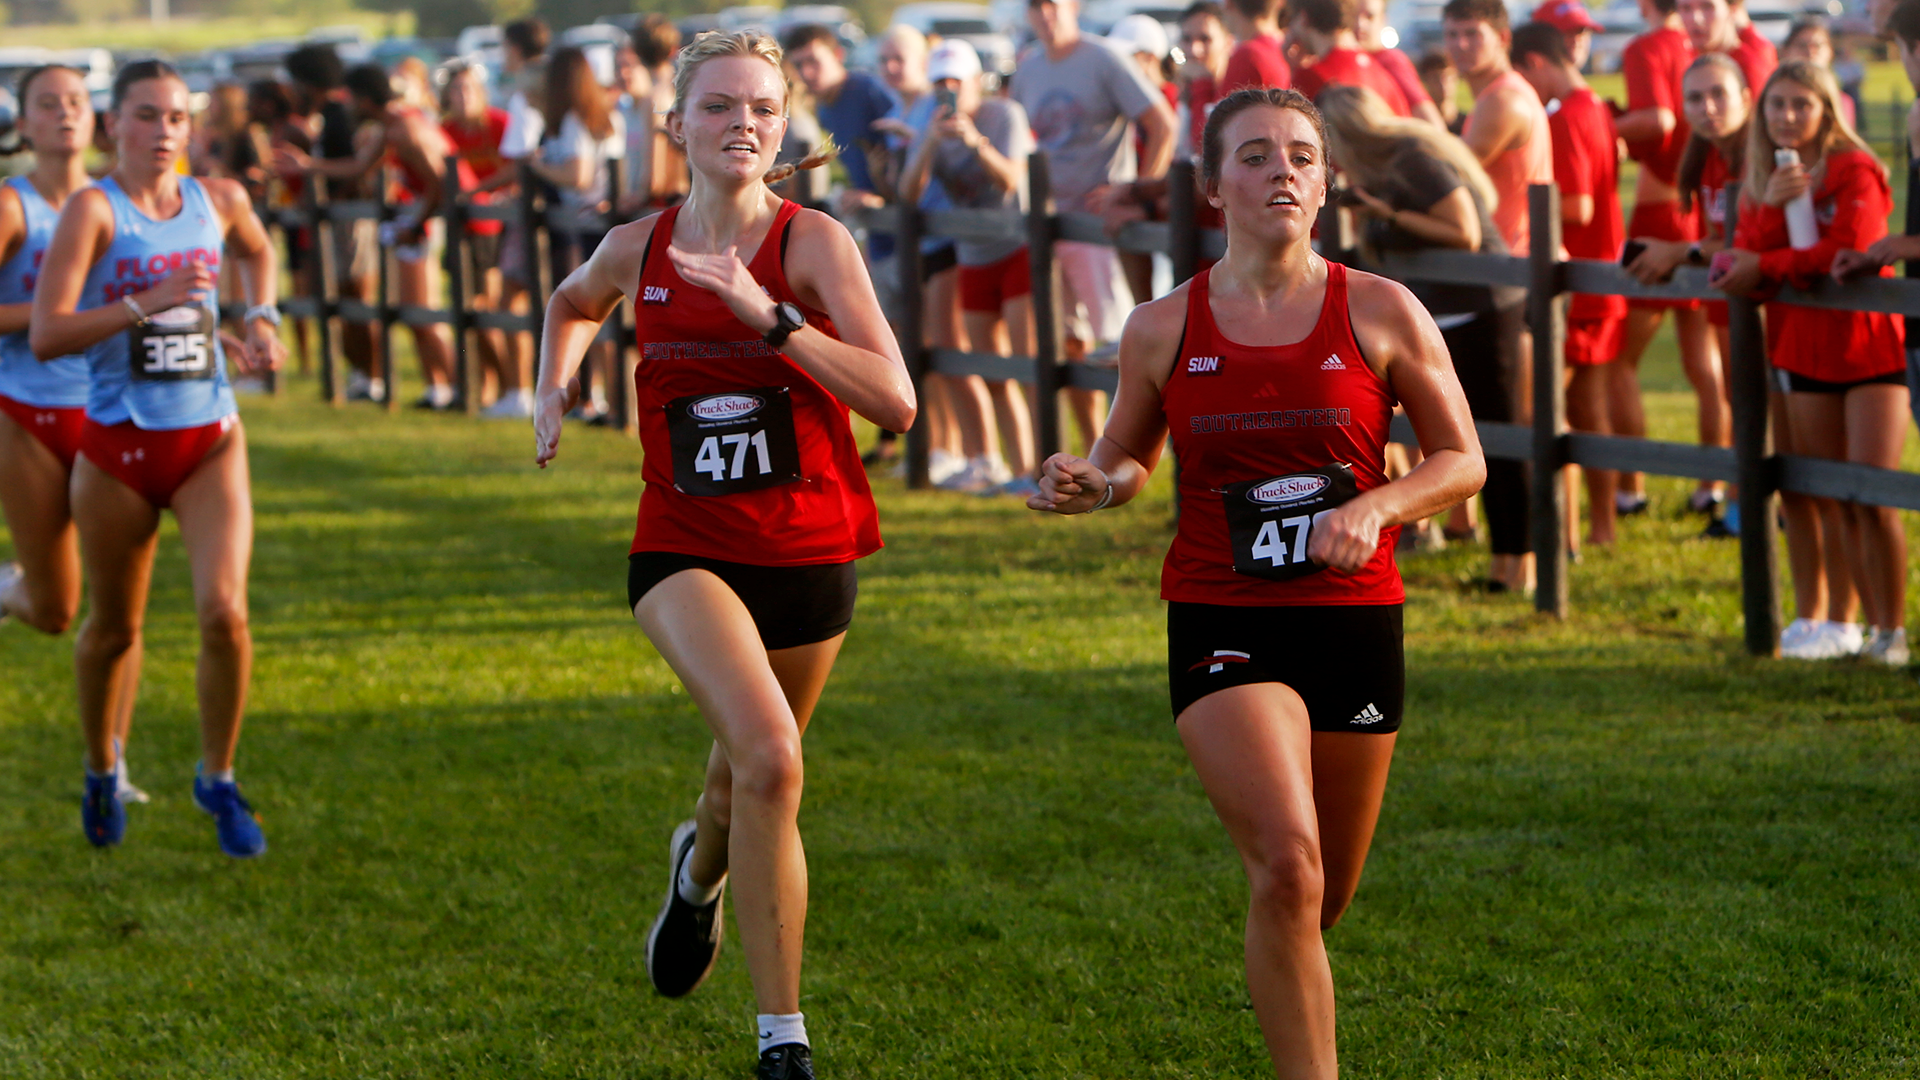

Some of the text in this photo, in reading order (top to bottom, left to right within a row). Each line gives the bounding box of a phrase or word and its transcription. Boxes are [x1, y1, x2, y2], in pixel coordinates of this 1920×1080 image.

[142, 333, 208, 373] 325
[1320, 363, 1347, 371] adidas
[693, 402, 724, 415] Track
[724, 397, 760, 412] Shack
[1190, 408, 1351, 434] SOUTHEASTERN
[694, 429, 772, 481] 471
[1253, 476, 1326, 500] Track Shack
[1251, 508, 1338, 567] 47
